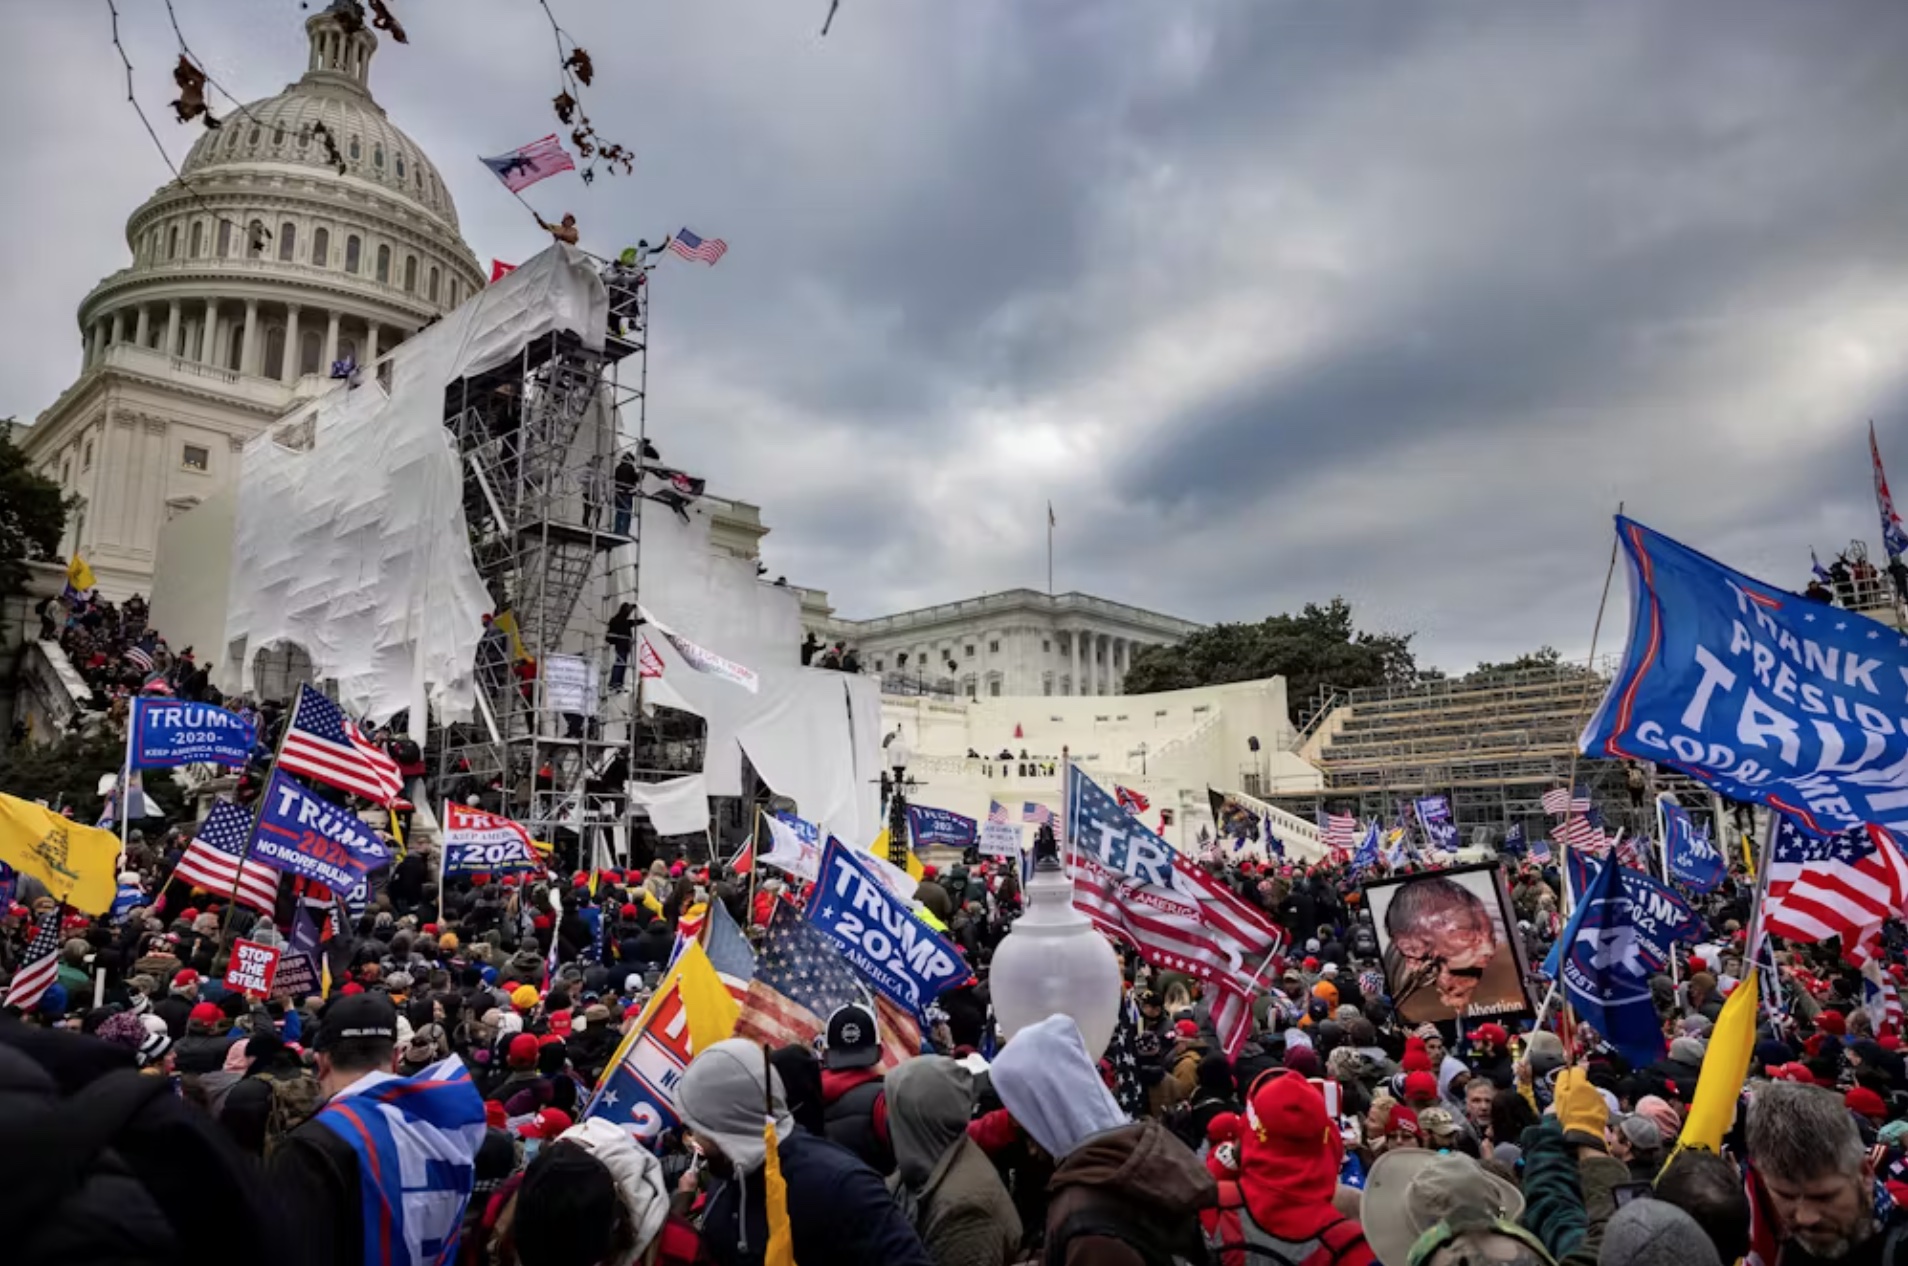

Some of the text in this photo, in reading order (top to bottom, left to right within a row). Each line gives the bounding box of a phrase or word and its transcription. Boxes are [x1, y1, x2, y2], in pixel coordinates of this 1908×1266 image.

[1725, 578, 1884, 696] THANK
[1729, 618, 1908, 738] PRESID
[144, 748, 169, 758] KEEP
[171, 745, 213, 756] AMERICA
[1635, 720, 1736, 769] GOD
[278, 784, 386, 858] TRUMP
[256, 839, 278, 855] NO
[277, 846, 318, 867] MORE
[834, 856, 957, 982] TRUMP
[237, 945, 274, 963] STOP
[239, 959, 266, 976] THE
[844, 948, 904, 997] AMERICA
[227, 970, 267, 992] STEAL
[1467, 1001, 1523, 1017] Abortion
